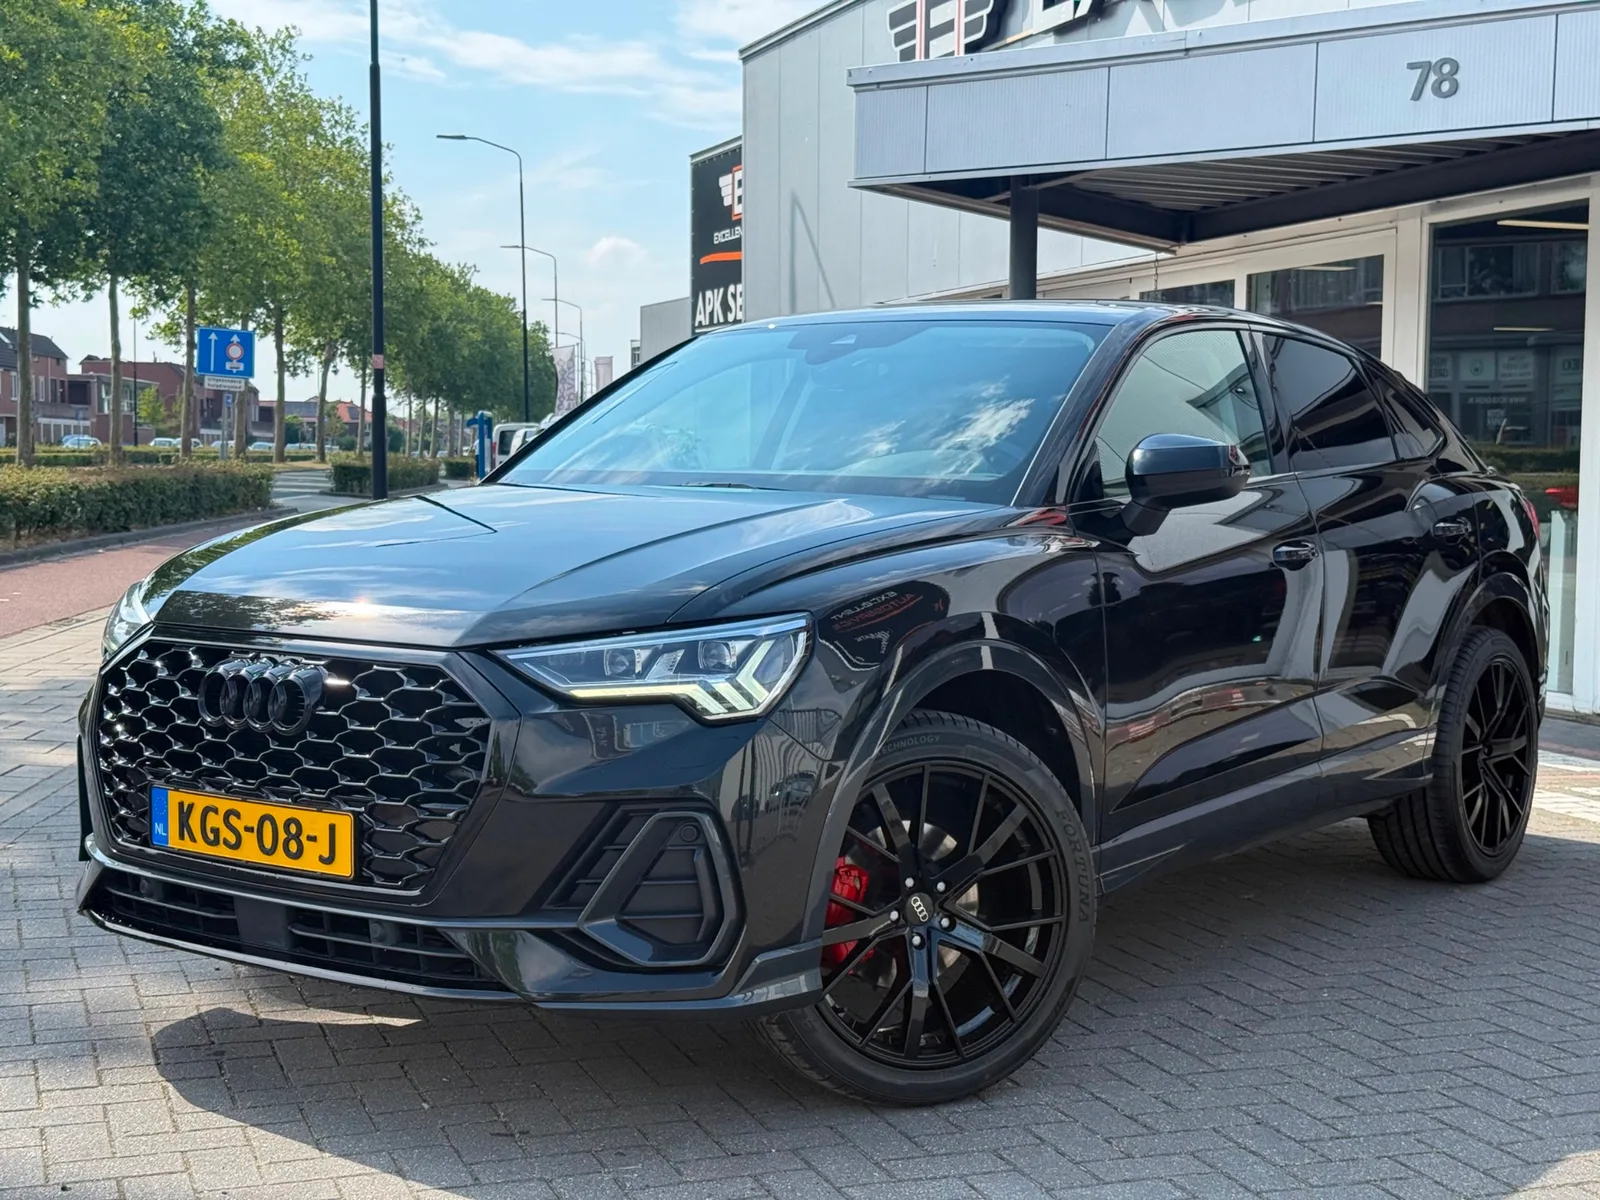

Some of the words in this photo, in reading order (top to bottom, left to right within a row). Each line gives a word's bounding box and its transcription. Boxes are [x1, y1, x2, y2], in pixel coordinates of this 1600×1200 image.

[1406, 57, 1459, 101] 78
[695, 287, 724, 327] APK
[154, 822, 167, 837] NL
[177, 800, 337, 866] KGS-08-J
[1054, 809, 1090, 923] FORTUNA
